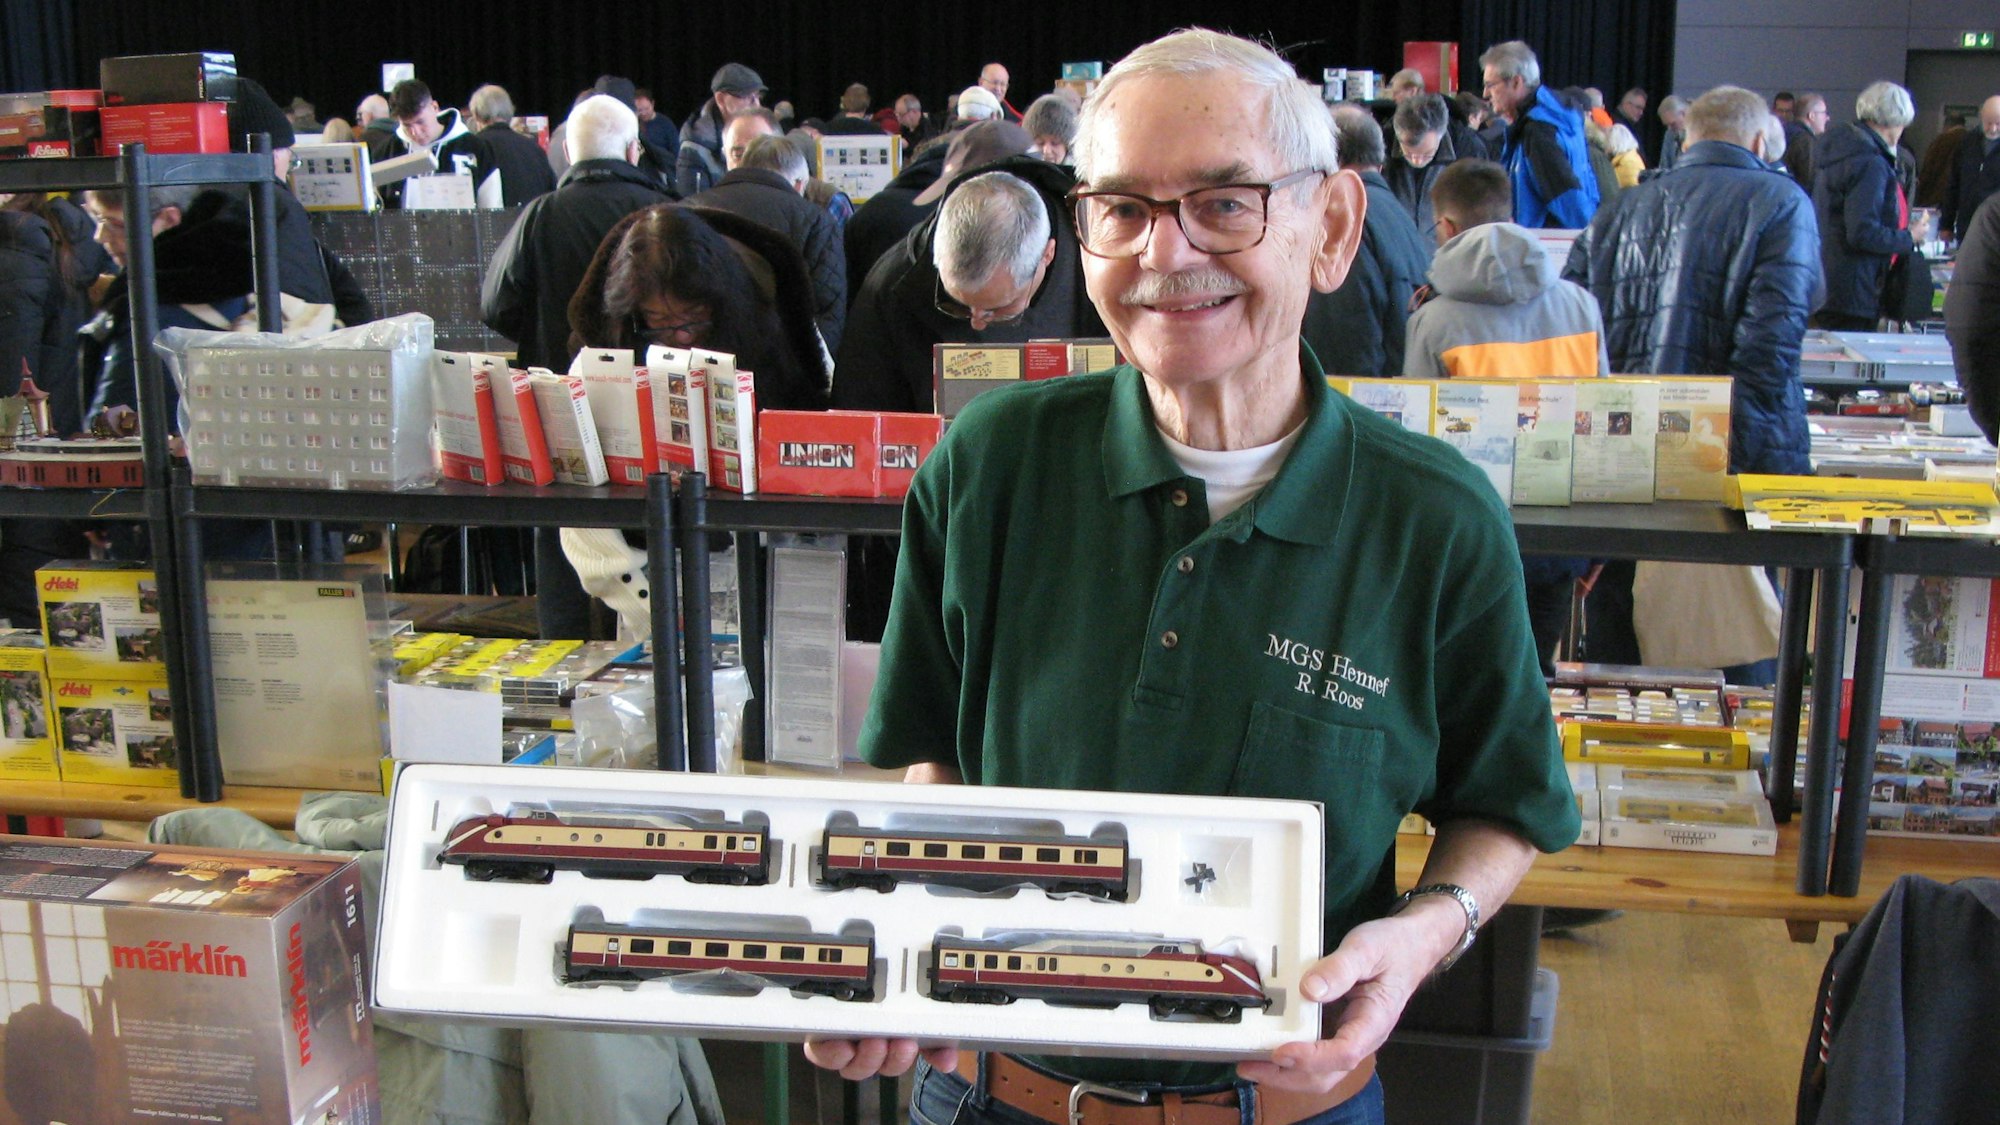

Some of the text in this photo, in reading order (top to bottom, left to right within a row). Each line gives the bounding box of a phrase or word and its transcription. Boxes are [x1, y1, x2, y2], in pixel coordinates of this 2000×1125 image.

[780, 443, 854, 468] UNION
[44, 576, 79, 592] Heki
[319, 588, 344, 596] FALLER
[1264, 633, 1390, 697] MGS Hennef
[59, 681, 92, 697] Heki
[1294, 672, 1364, 710] R. Roos
[344, 883, 357, 928] 1611
